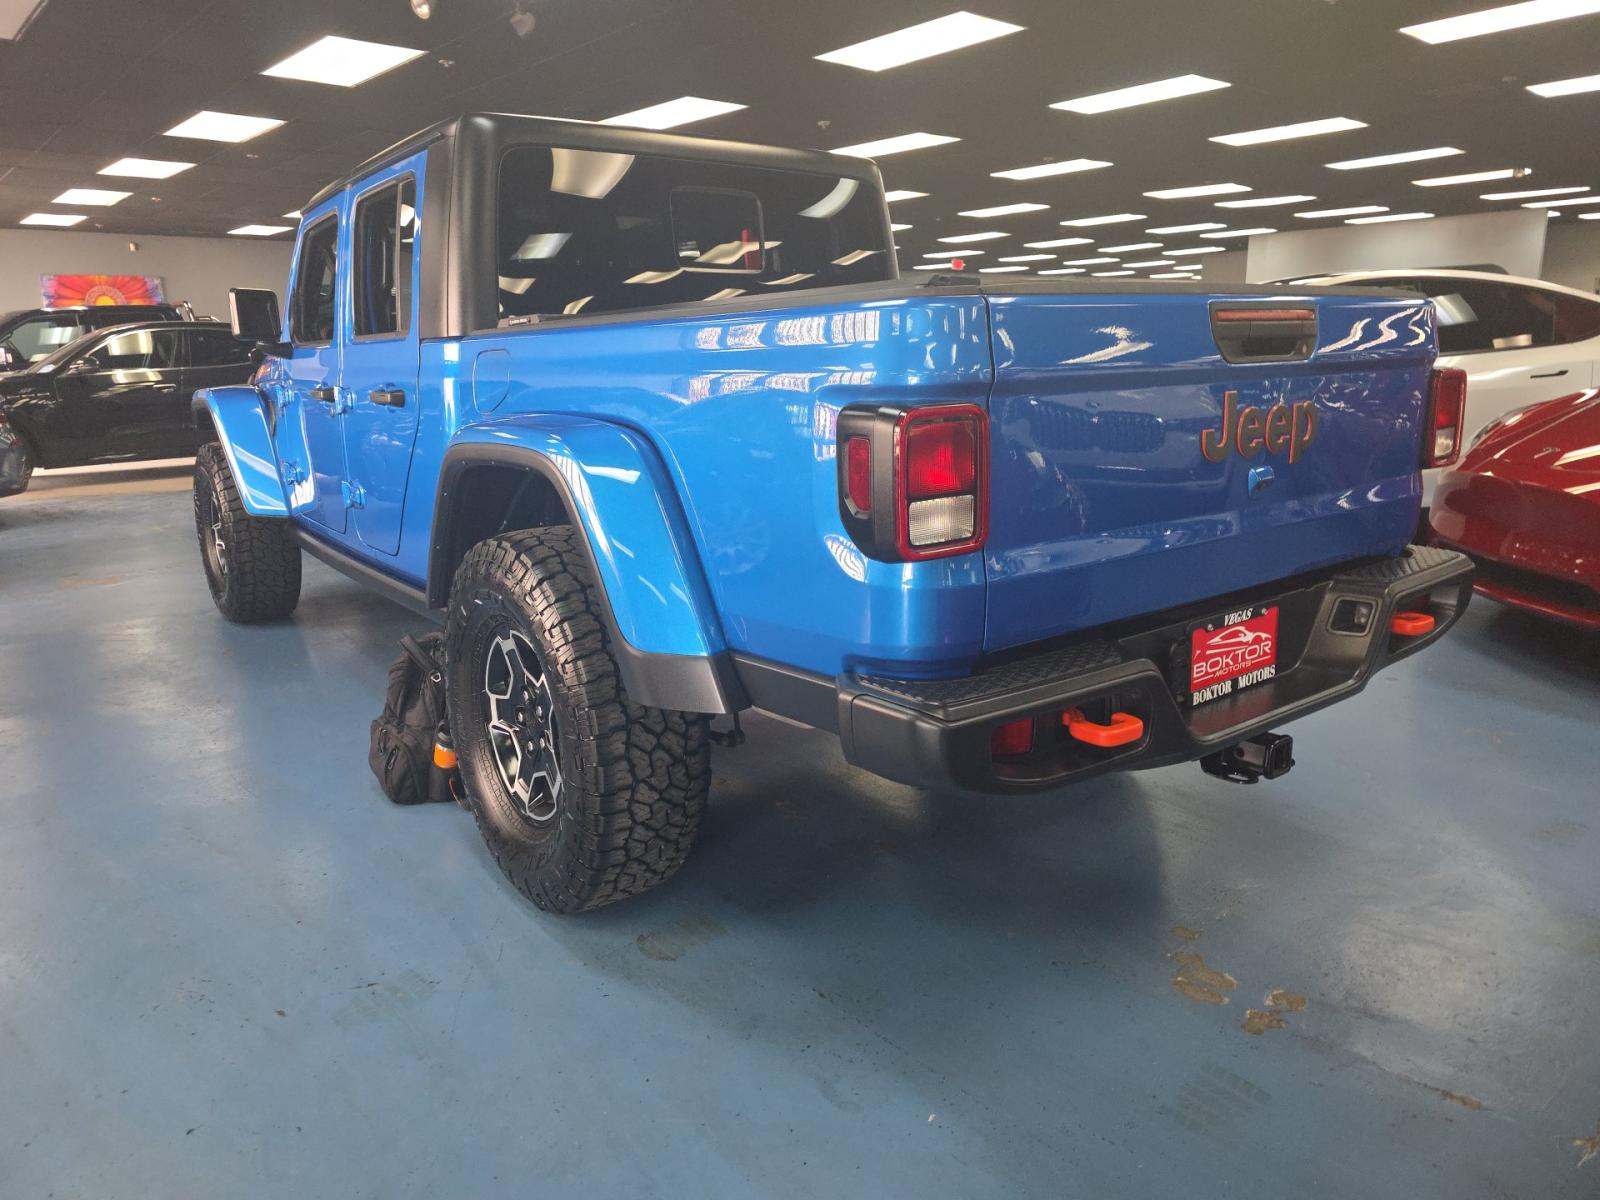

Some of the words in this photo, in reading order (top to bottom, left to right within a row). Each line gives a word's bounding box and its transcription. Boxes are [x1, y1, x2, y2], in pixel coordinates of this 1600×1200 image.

[1201, 390, 1317, 464] Jeep
[1224, 608, 1253, 626] VEGAS
[1193, 641, 1272, 678] BOKTOR
[1214, 661, 1252, 678] MOTORS
[1192, 680, 1232, 706] BOKTOR
[1237, 664, 1276, 690] MOTORS
